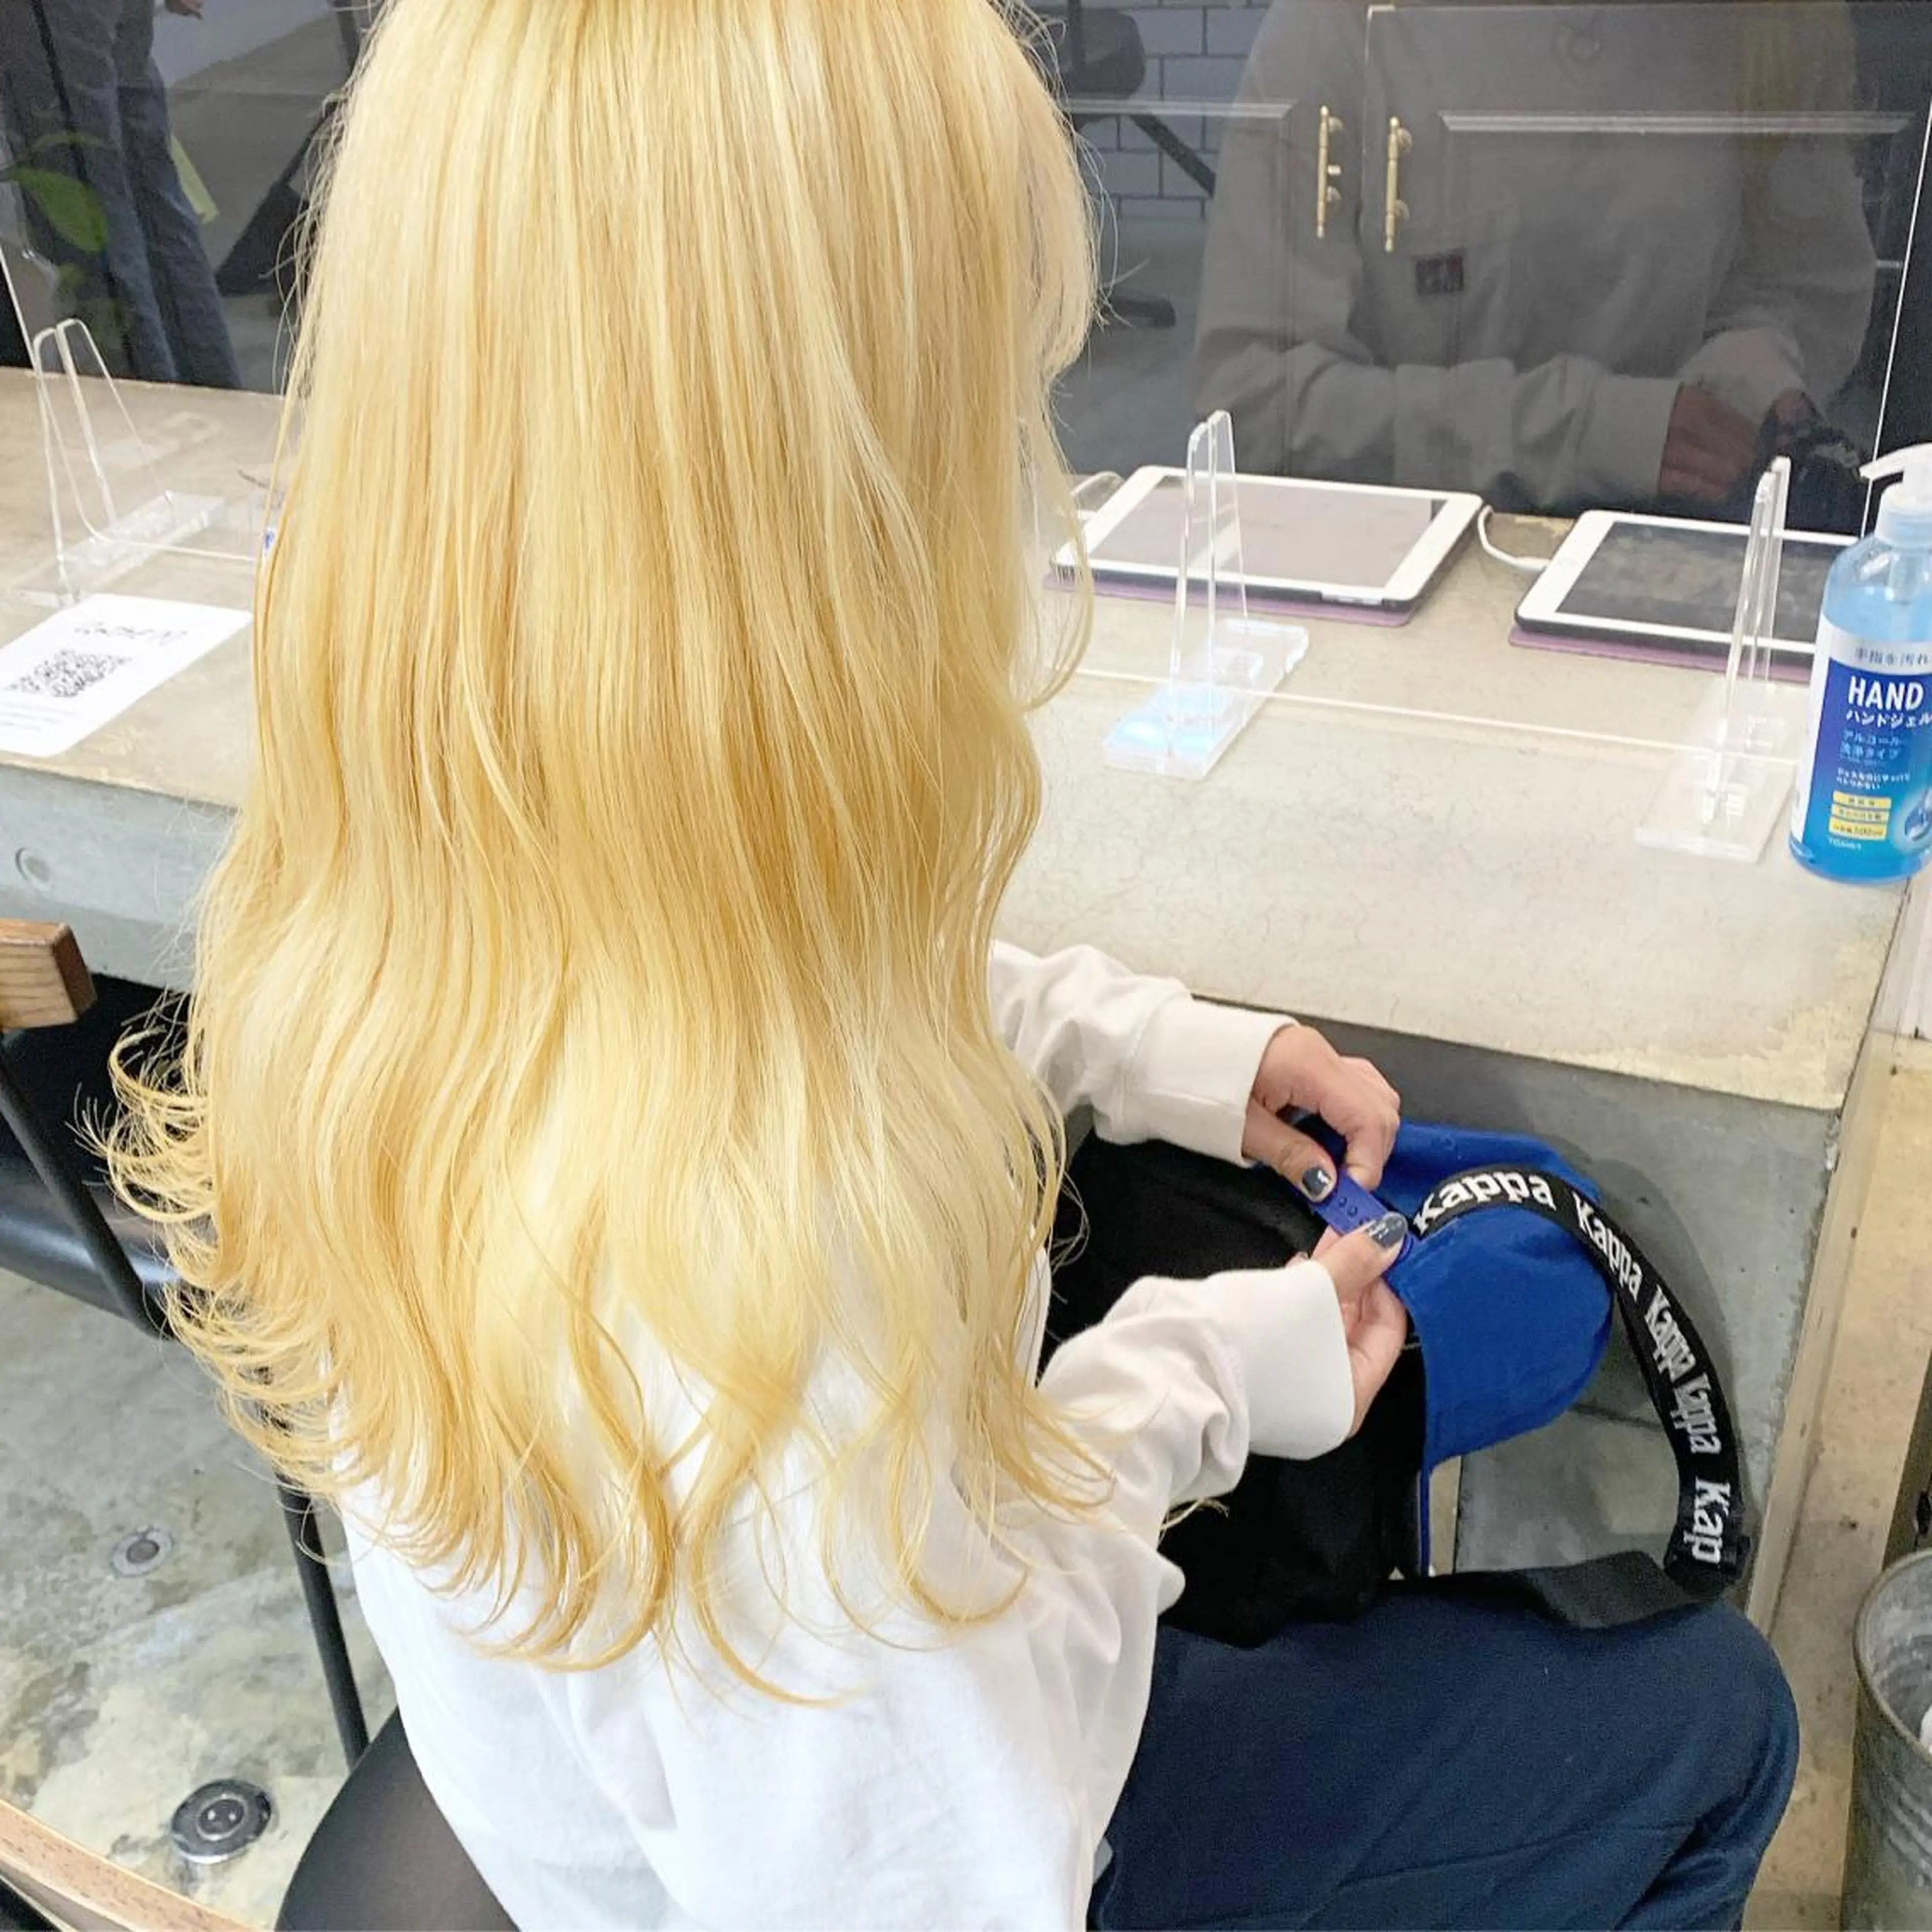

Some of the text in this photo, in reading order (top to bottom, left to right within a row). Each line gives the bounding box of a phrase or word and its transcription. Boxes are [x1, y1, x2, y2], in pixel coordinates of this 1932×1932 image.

[1848, 675, 1924, 711] HAND
[1413, 1171, 1557, 1235] Kappa
[1572, 1192, 1643, 1302] Kappa
